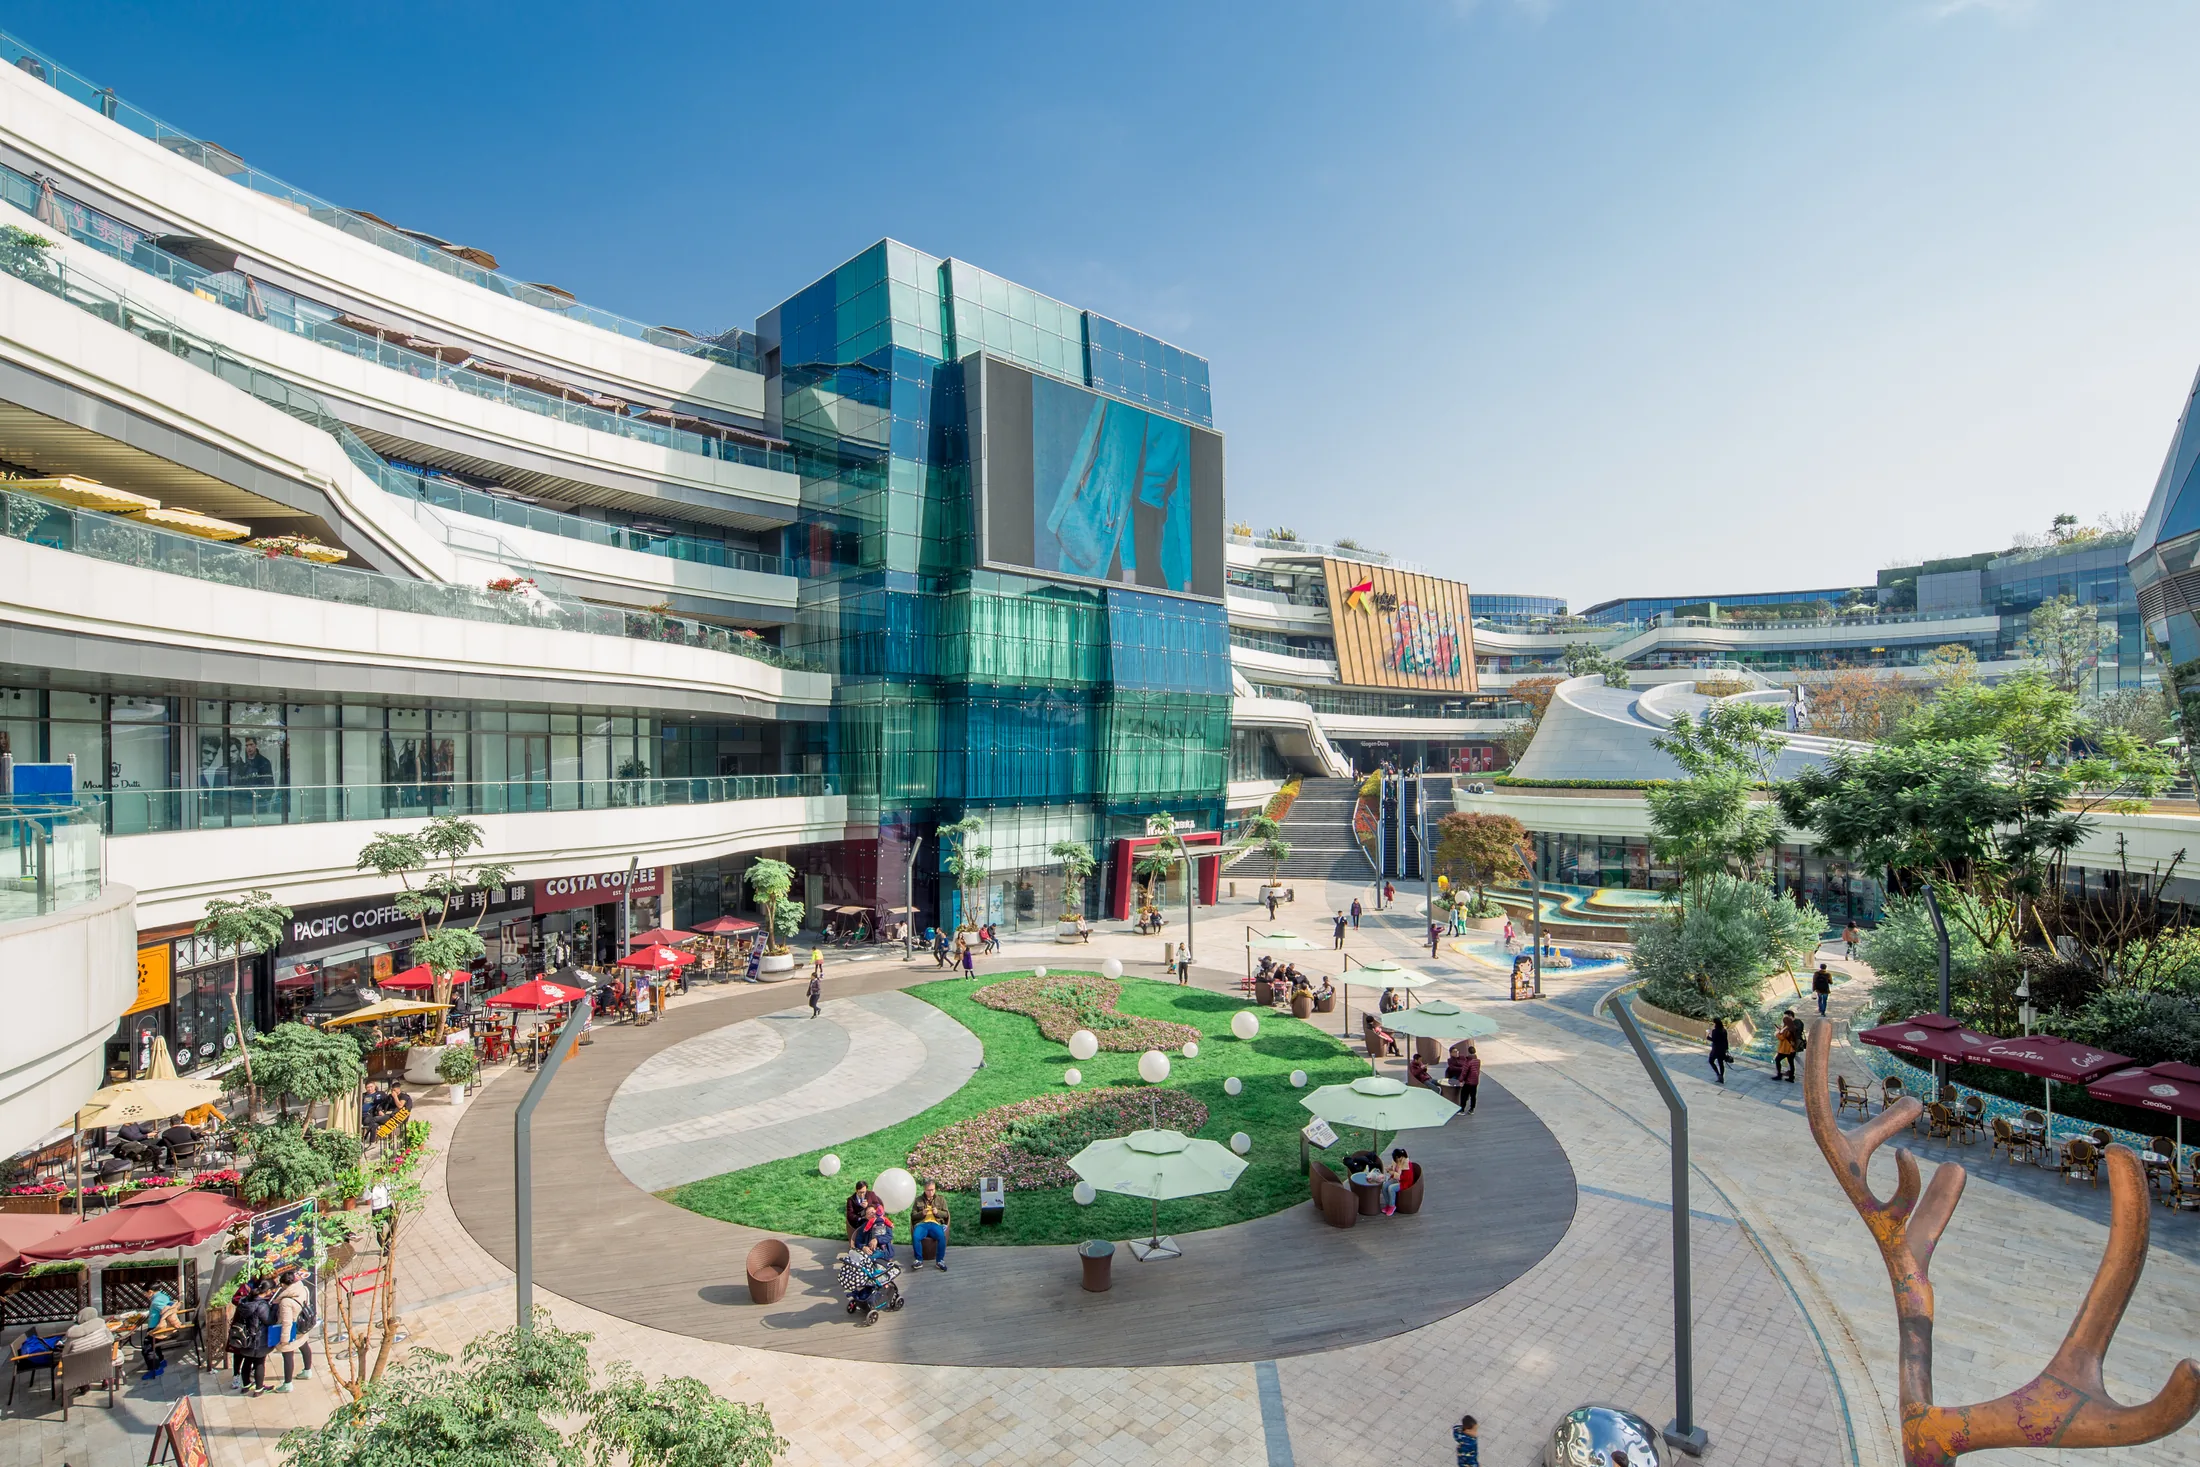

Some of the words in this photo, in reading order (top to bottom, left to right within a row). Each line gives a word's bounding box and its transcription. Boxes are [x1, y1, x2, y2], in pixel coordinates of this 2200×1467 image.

[1128, 718, 1207, 739] ZARA
[120, 779, 142, 788] Dutti
[546, 875, 597, 896] COSTA
[600, 868, 656, 888] COFFEE
[634, 885, 656, 893] LONDON
[294, 914, 349, 941] PACIFIC
